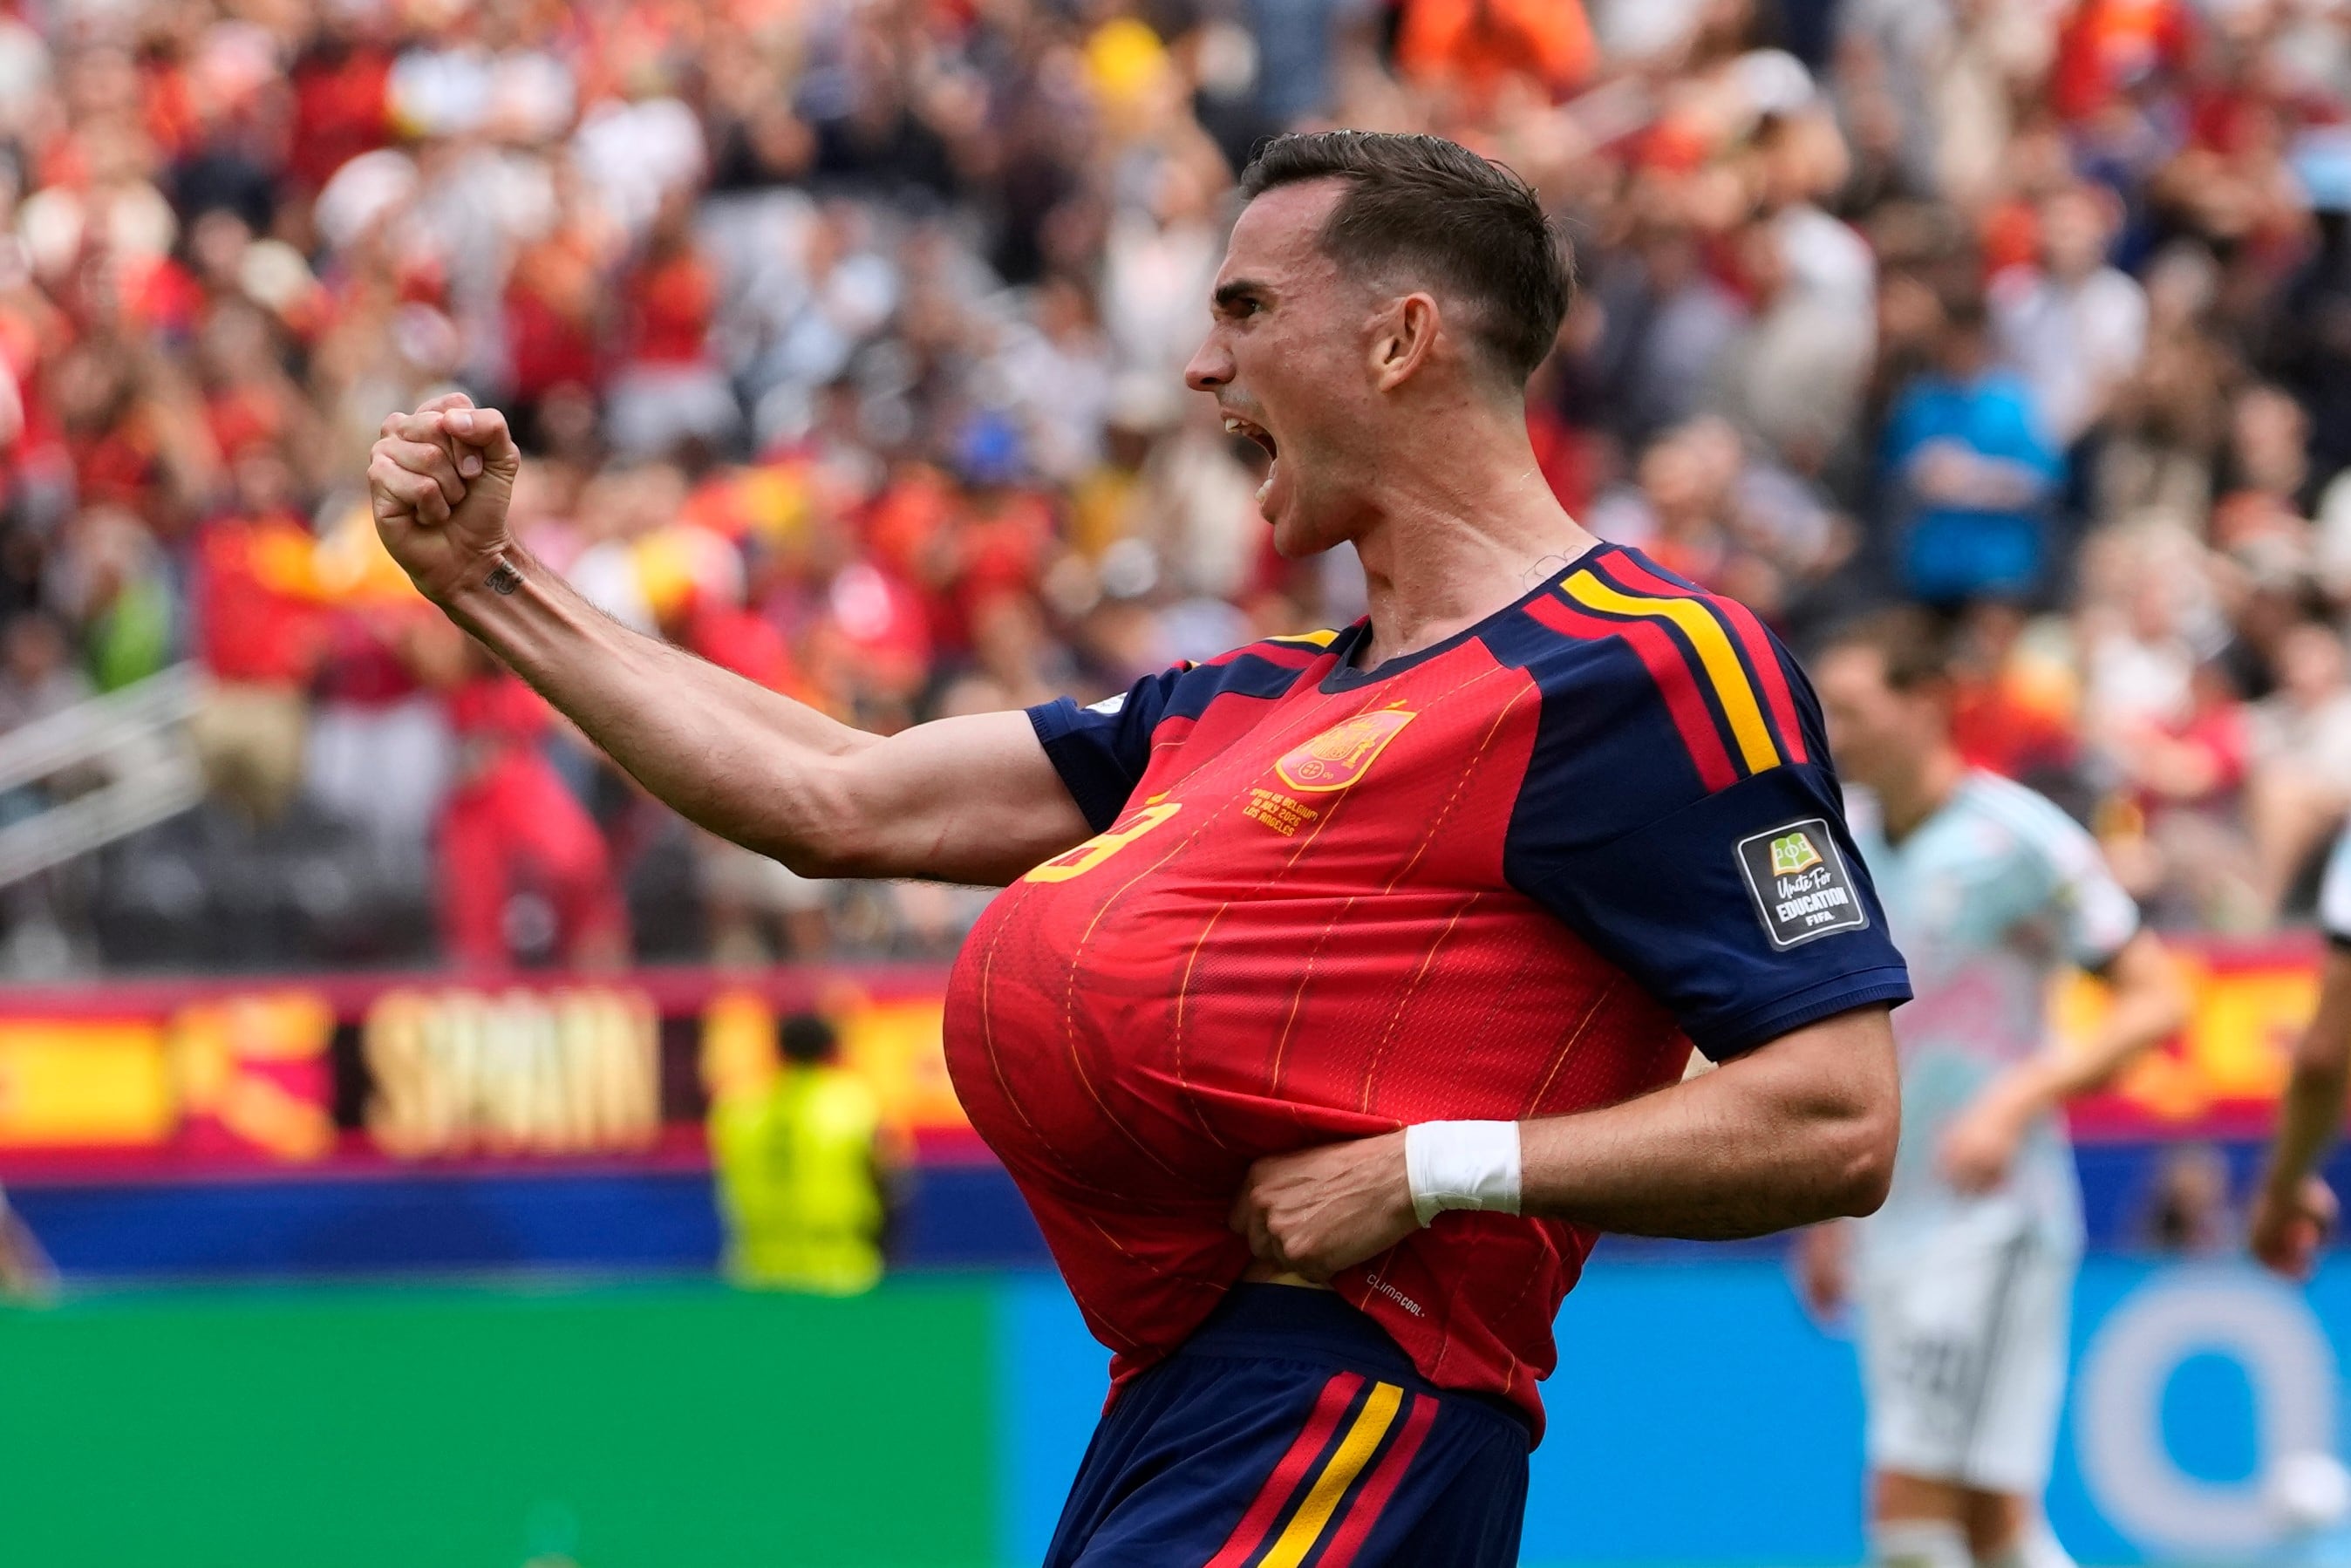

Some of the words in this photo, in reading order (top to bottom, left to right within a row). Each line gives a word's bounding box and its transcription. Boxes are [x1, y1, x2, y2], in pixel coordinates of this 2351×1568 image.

[1243, 806, 1260, 818] LOS
[1258, 811, 1295, 836] ANGELES
[1260, 801, 1280, 814] JULY
[1278, 808, 1301, 827] 2026
[1282, 797, 1319, 821] BELGIUM
[1023, 802, 1182, 883] 8
[1776, 874, 1813, 899] Unite
[1809, 866, 1831, 889] For
[1775, 887, 1849, 923] EDUCATION
[1805, 910, 1834, 926] FIFA
